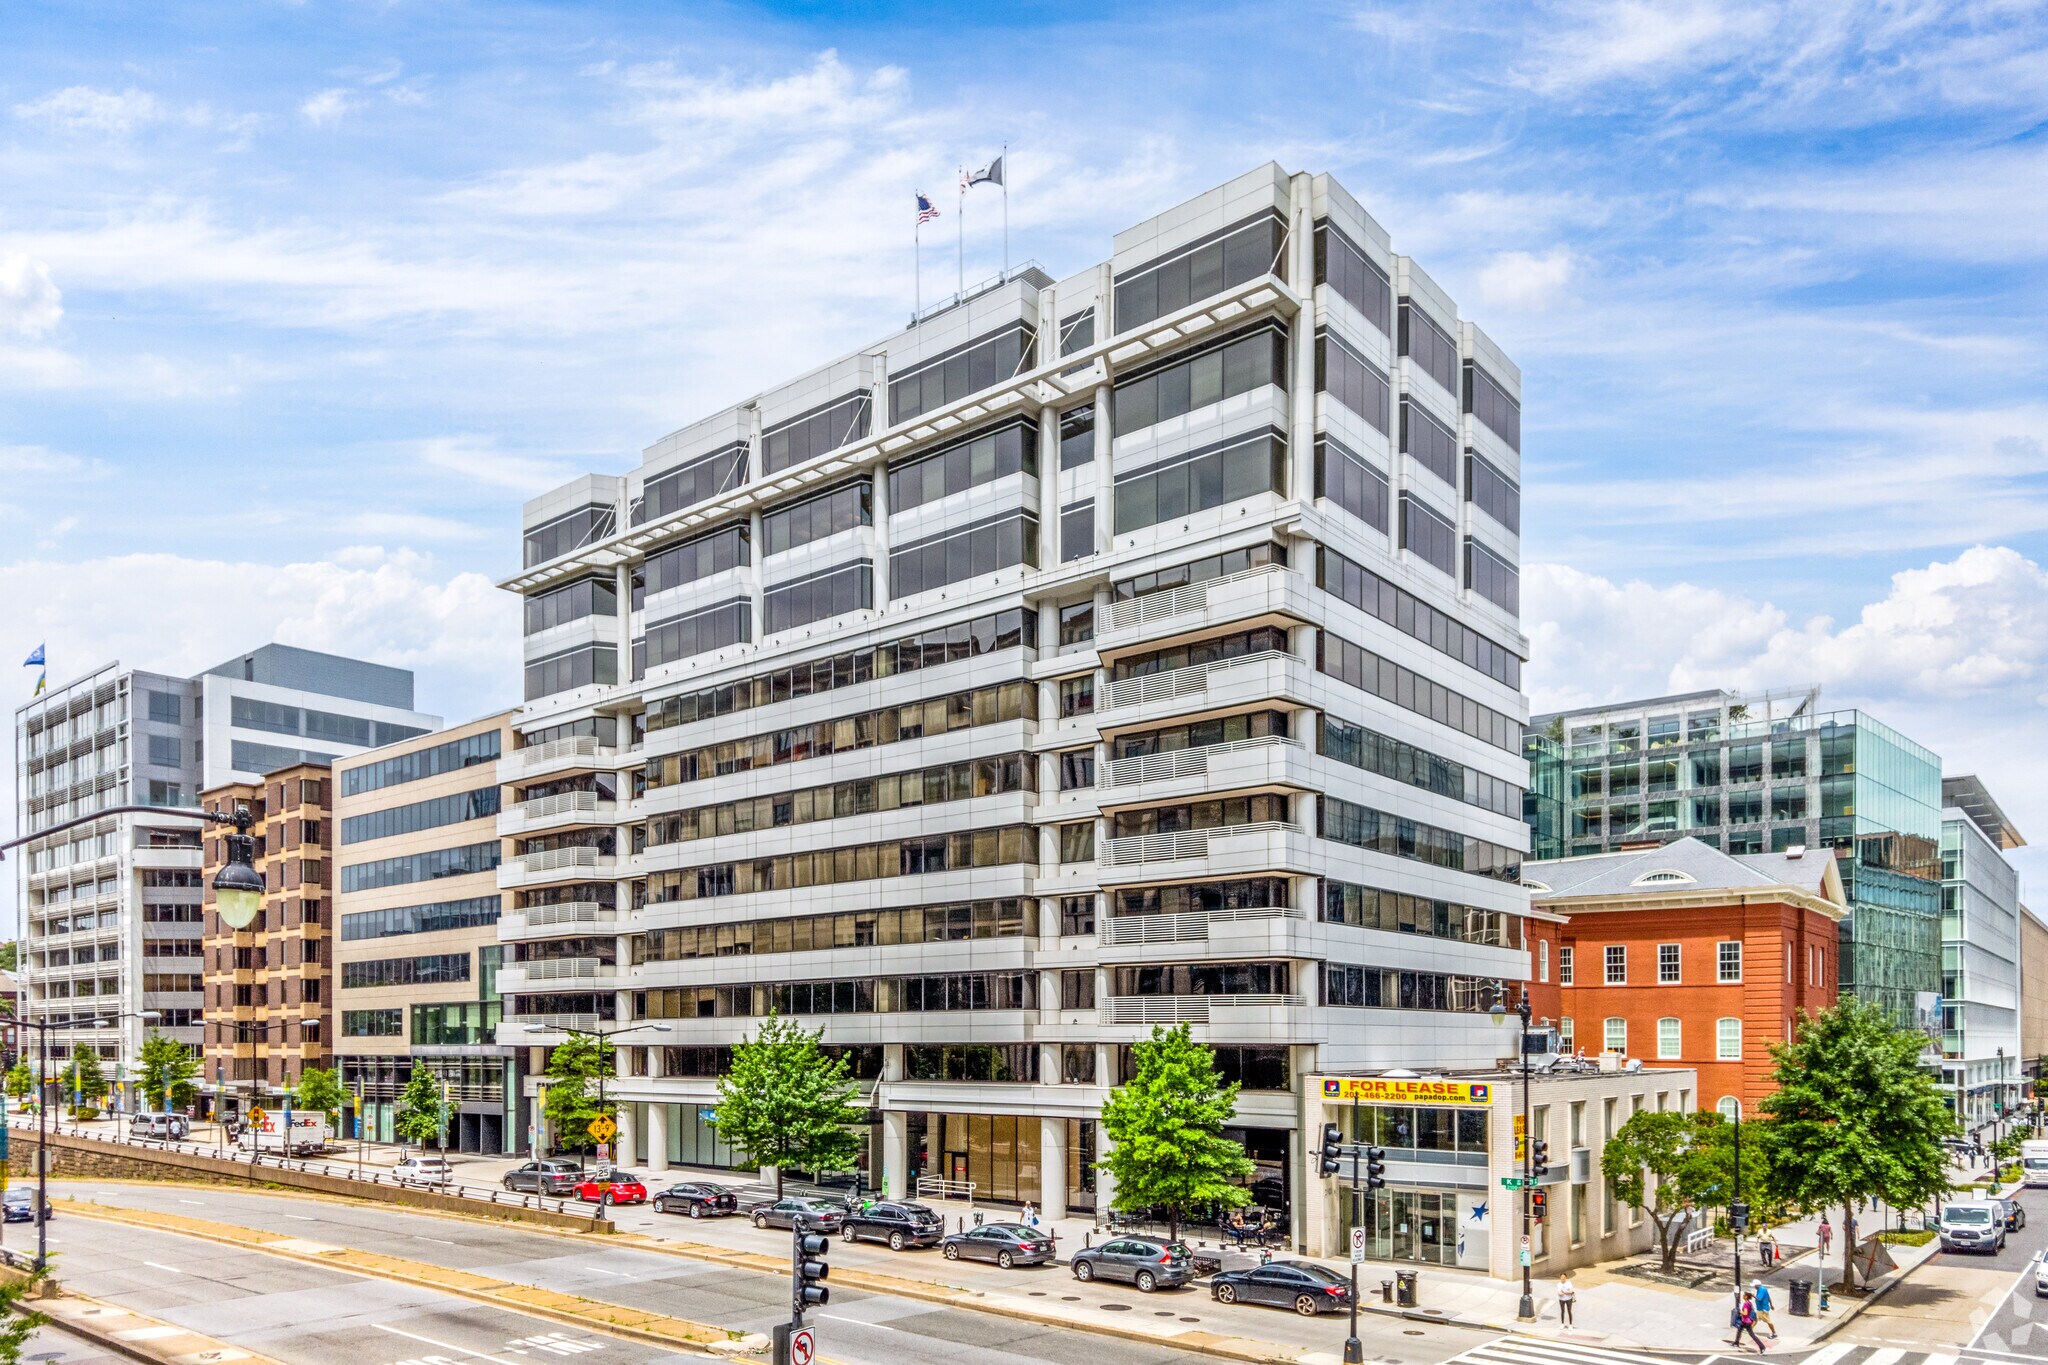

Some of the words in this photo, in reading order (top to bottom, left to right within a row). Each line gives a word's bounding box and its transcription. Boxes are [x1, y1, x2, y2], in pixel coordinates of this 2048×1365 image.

[1349, 1080, 1387, 1092] FOR
[1395, 1082, 1458, 1094] LEASE
[1414, 1093, 1466, 1101] papadop.com
[291, 1118, 317, 1128] FedEx
[598, 1169, 609, 1177] 25
